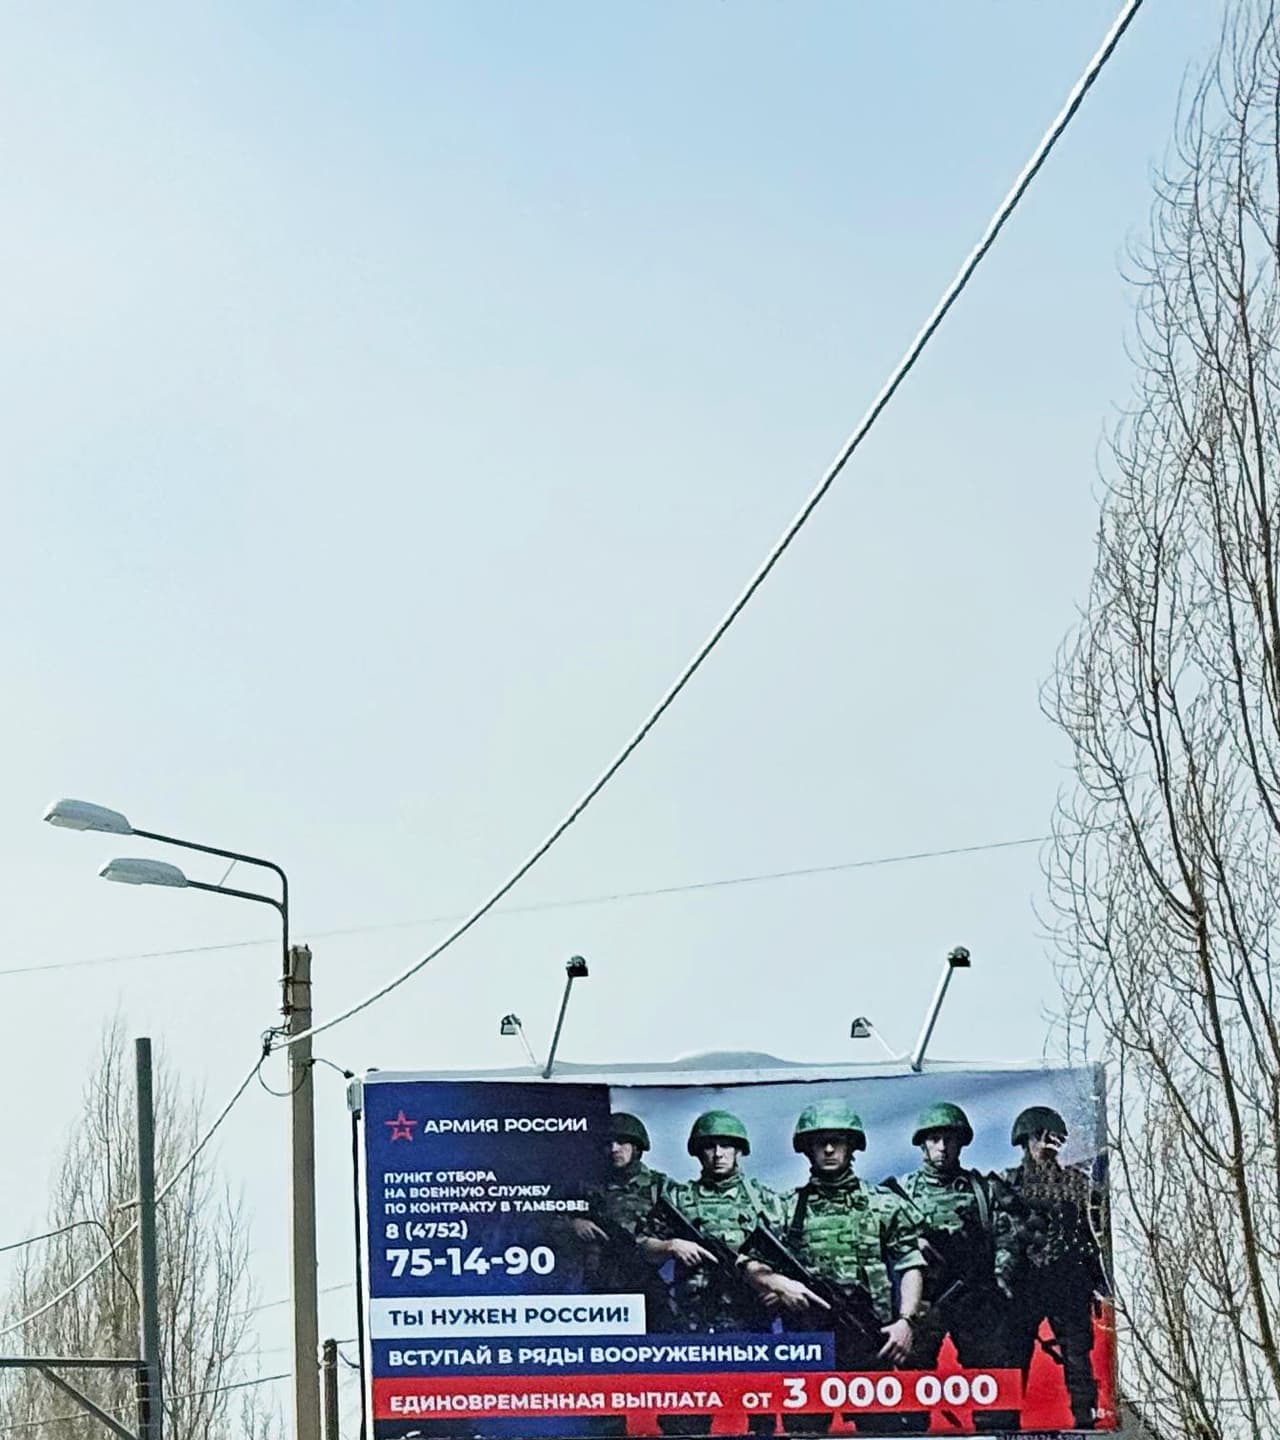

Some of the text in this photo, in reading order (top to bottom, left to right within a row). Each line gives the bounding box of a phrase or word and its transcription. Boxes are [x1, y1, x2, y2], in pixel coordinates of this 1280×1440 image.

[424, 1117, 588, 1134] АРМИЯ РОССИИ
[384, 1171, 496, 1184] ПУНКТ ОТБОРА
[385, 1185, 551, 1199] НА ВОЕННУЮ СЛУЖБУ
[385, 1203, 405, 1215] ПО
[409, 1202, 496, 1214] КОНТРАКТУ
[500, 1201, 510, 1213] В
[386, 1220, 468, 1240] 8 (4752)
[386, 1246, 555, 1277] 75-14-90
[389, 1306, 629, 1327] ТЫ НУЖЕН РОССИИ!
[389, 1343, 822, 1366] ВСТУПАЙ В РЯДЫ ВООРУЖЕННЫХ СИЛ
[390, 1392, 605, 1414] ЕДИНОВРЕМЕННАЯ
[611, 1390, 724, 1410] ВЫПЛАТА
[783, 1377, 807, 1407] 3
[820, 1375, 903, 1408] 000
[915, 1374, 998, 1407] 000
